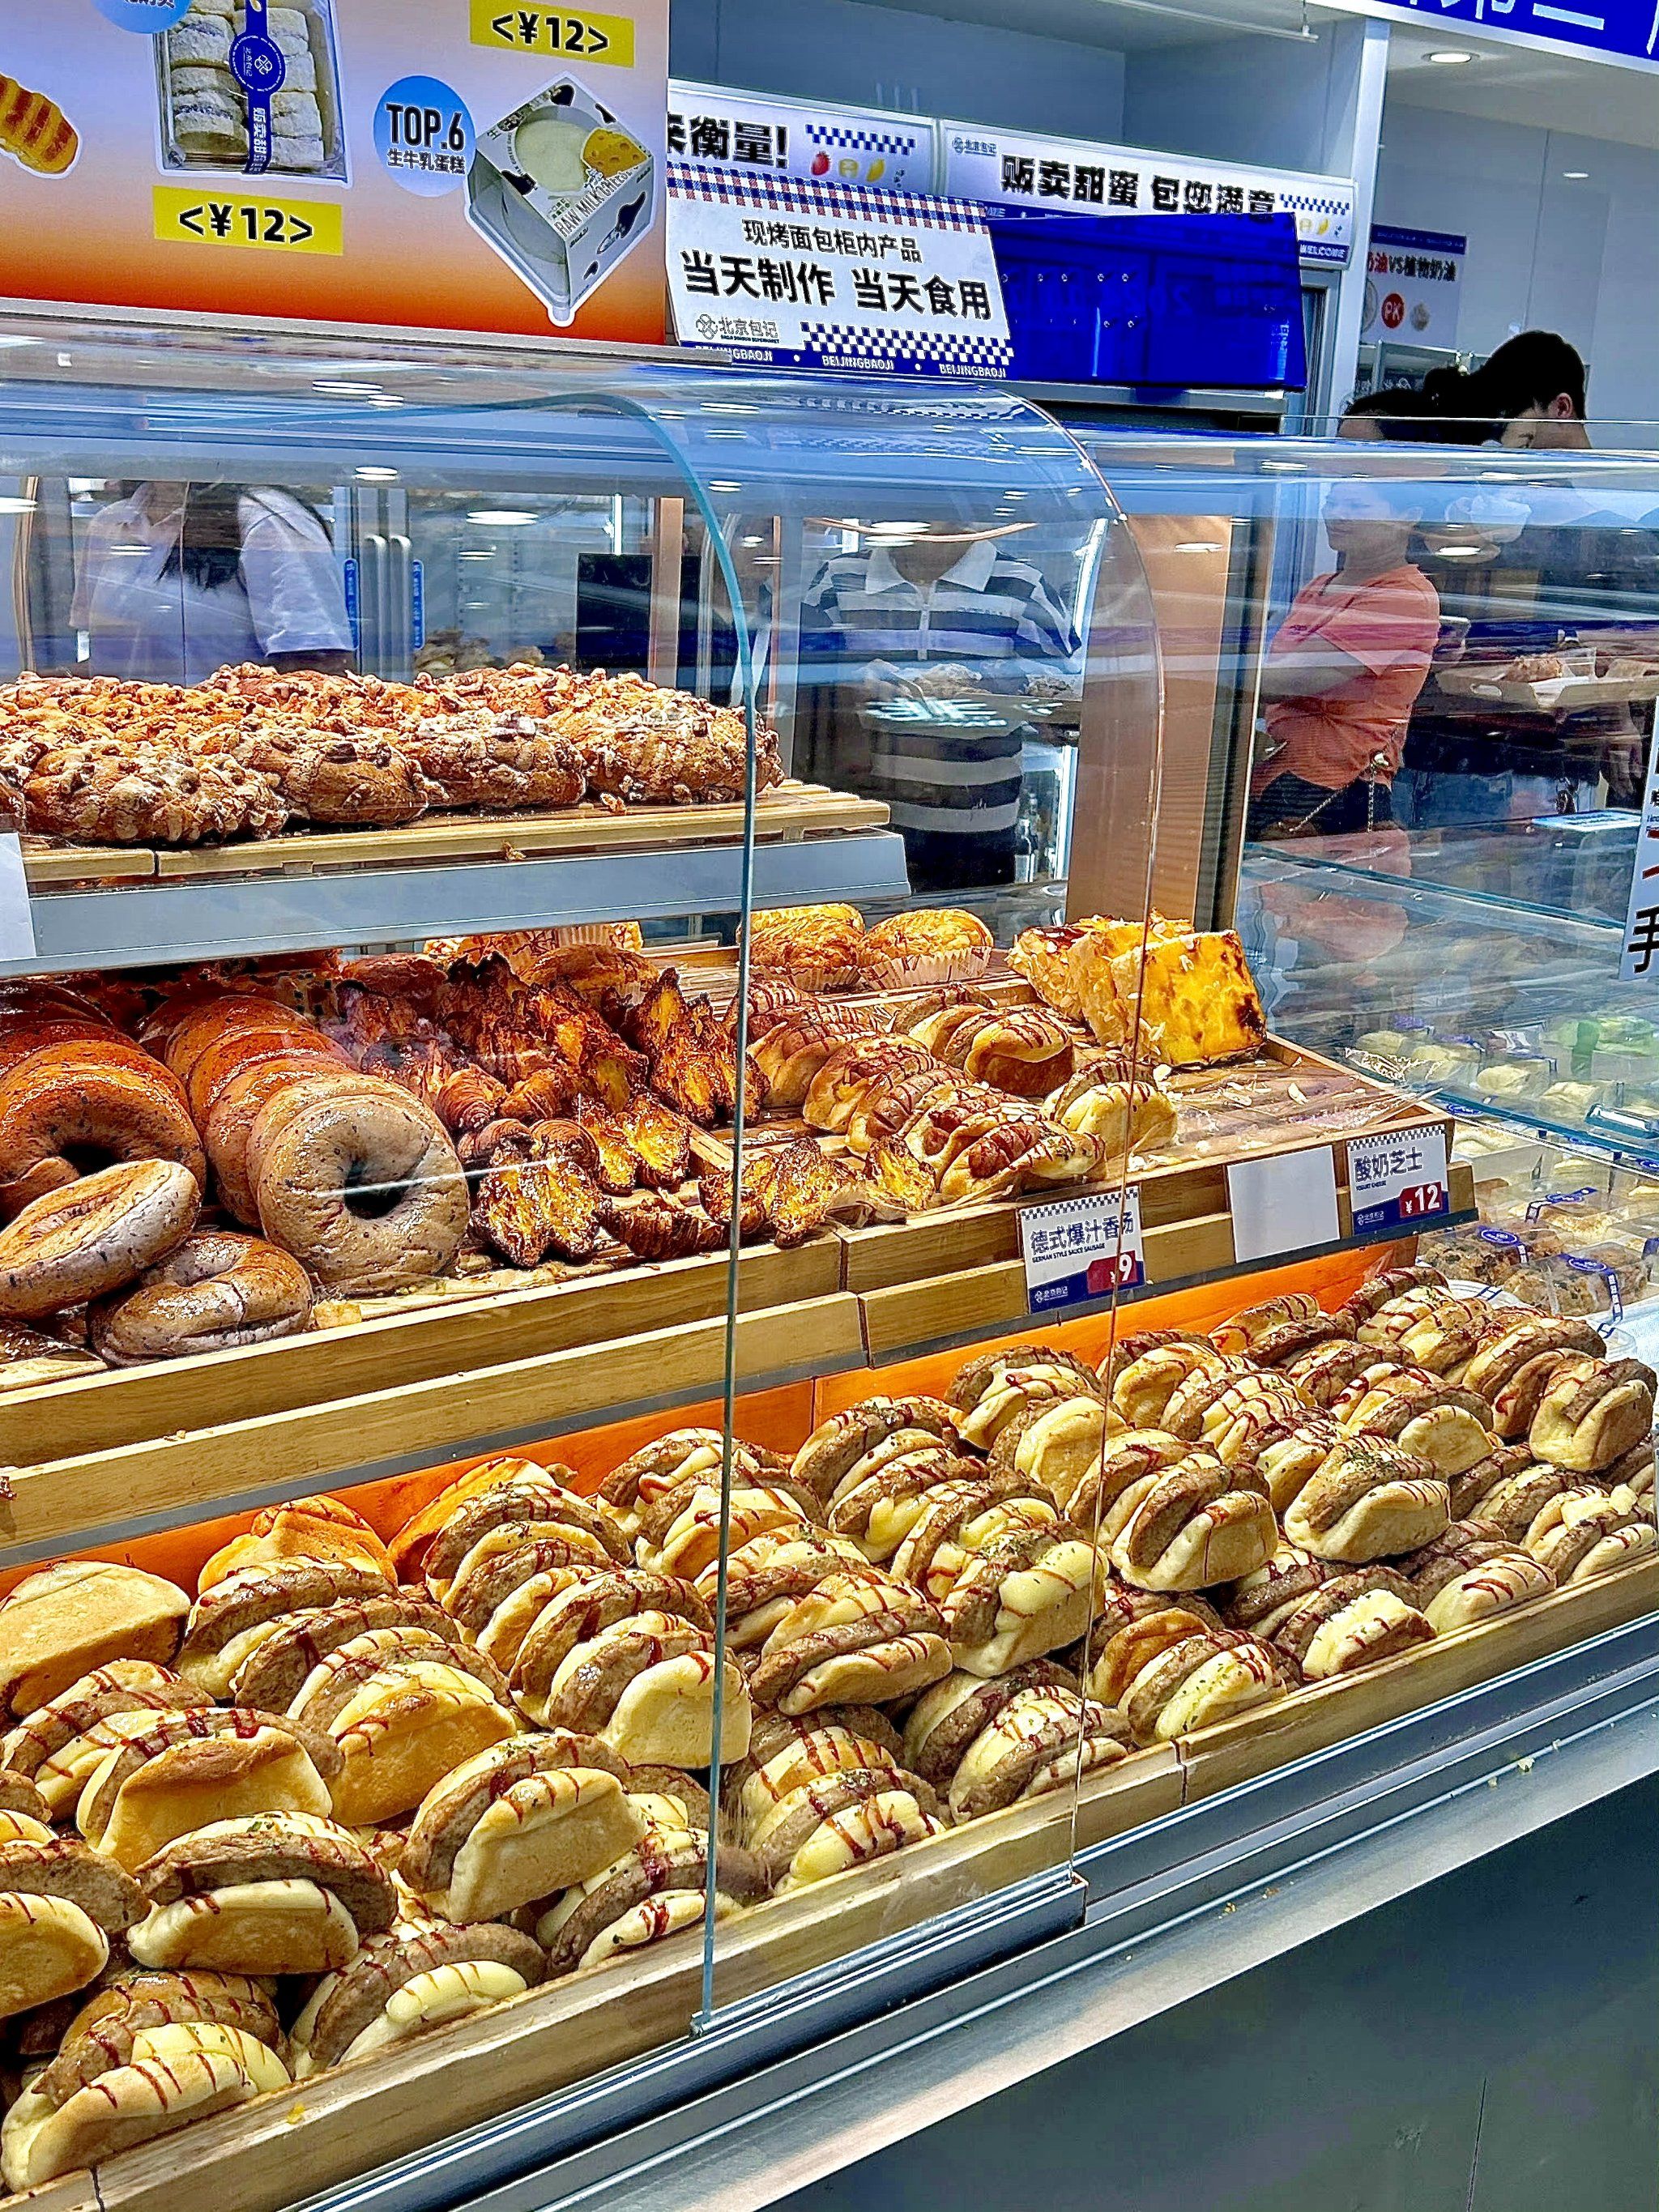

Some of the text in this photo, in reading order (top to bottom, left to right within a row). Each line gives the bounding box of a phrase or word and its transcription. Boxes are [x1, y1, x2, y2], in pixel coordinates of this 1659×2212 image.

[386, 103, 465, 151] TOP.6
[386, 148, 467, 175] 生牛乳蛋糕
[741, 218, 922, 264] 现烤面包柜内产品
[680, 249, 835, 307] 当天制作
[851, 267, 992, 321] 当天食用
[1384, 301, 1402, 321] PK
[719, 317, 778, 339] 北京包记
[821, 355, 895, 371] BEIJINGBAOJI
[938, 363, 1007, 379] BEIJINGBAOJI
[1354, 1147, 1422, 1182] 酸奶芝士
